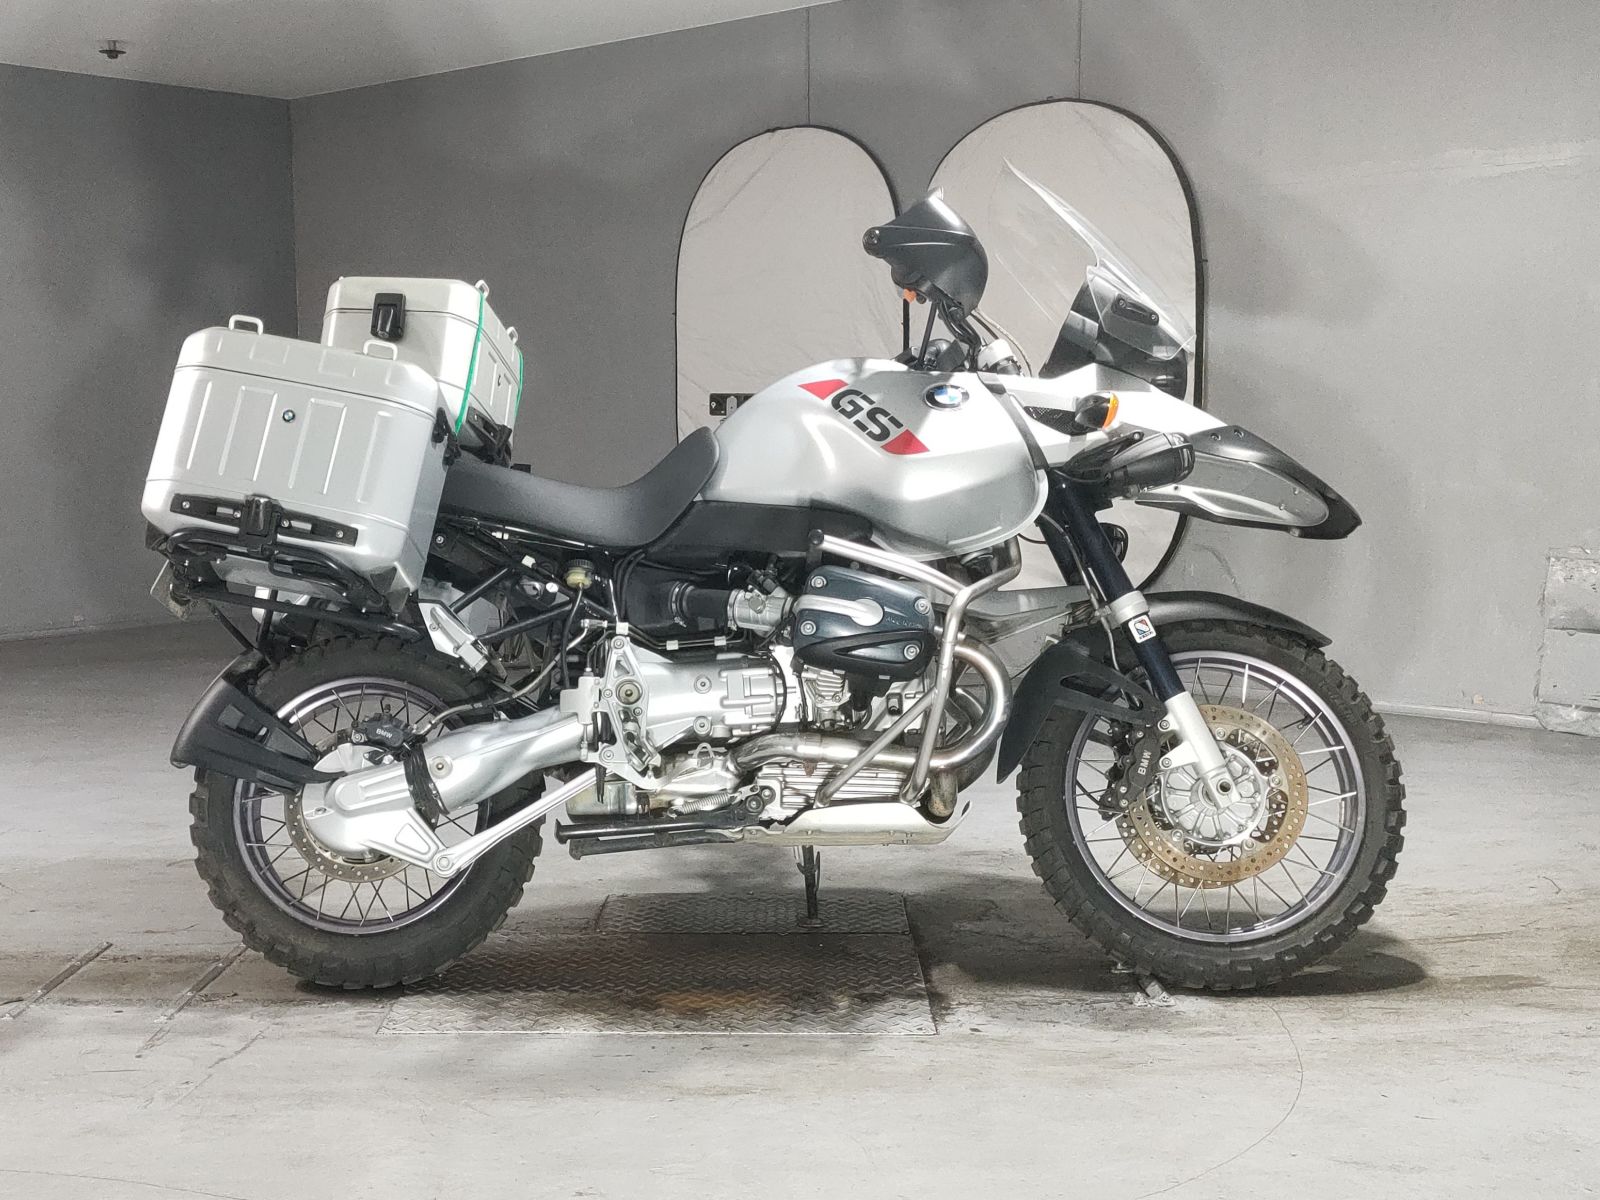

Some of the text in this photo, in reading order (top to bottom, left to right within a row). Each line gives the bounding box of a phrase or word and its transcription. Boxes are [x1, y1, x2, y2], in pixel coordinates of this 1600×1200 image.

[831, 389, 903, 442] GS
[376, 728, 393, 739] BMW
[1137, 750, 1152, 775] BMW
